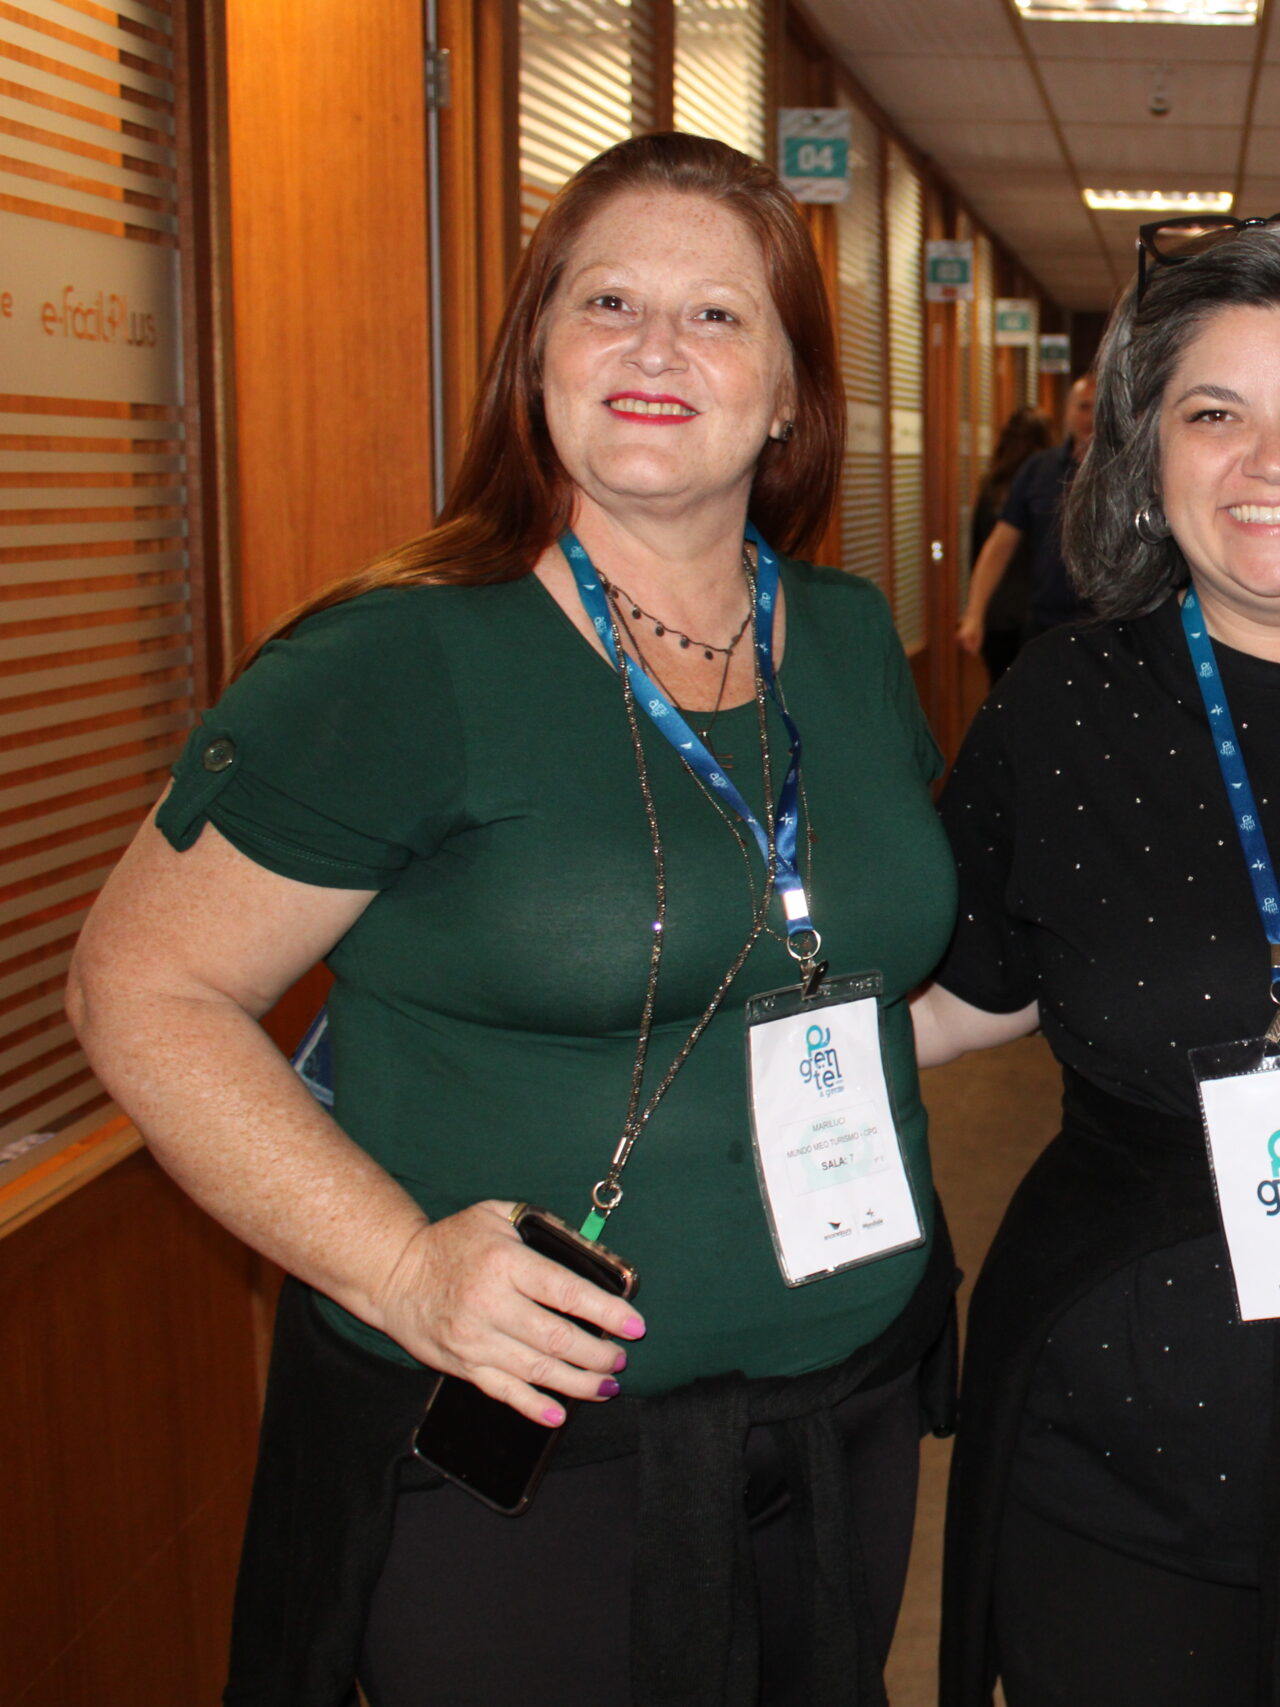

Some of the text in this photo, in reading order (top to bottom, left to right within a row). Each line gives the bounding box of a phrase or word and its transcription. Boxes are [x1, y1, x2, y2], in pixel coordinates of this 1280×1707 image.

[797, 145, 834, 172] 04
[786, 1145, 813, 1158] MUNDO
[830, 1132, 859, 1146] TURISMO
[821, 1157, 847, 1171] SALA:
